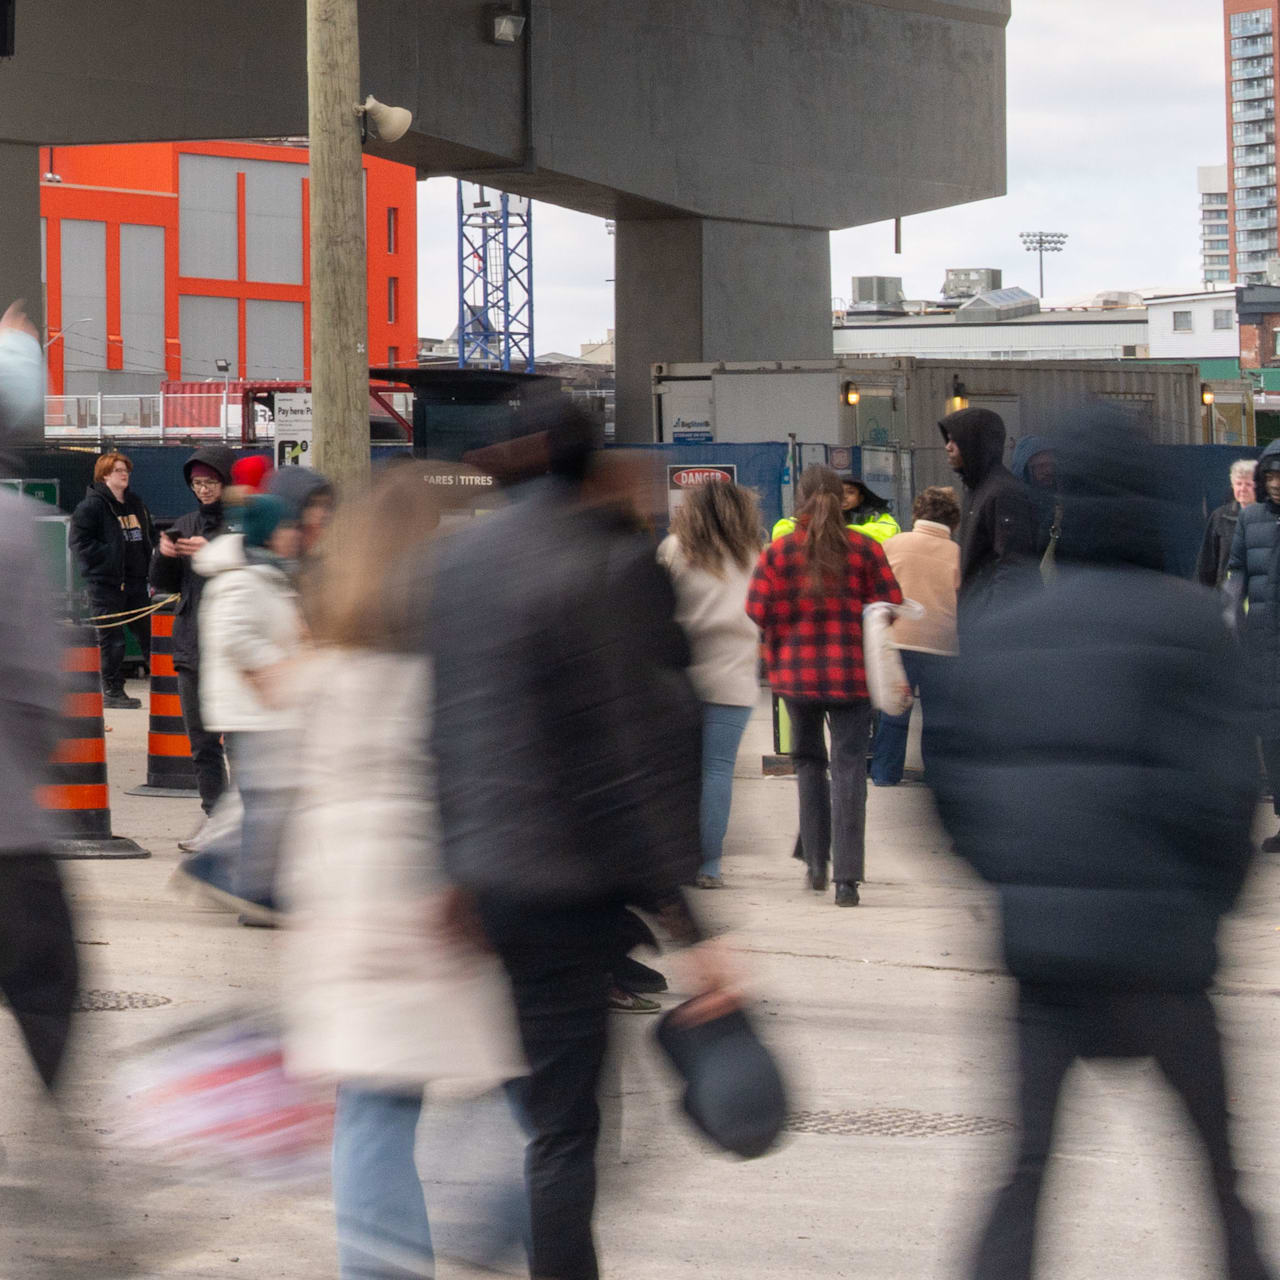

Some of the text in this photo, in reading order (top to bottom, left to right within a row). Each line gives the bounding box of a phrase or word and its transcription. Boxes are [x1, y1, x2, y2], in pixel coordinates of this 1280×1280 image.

[278, 407, 289, 417] Pay
[423, 475, 493, 485] FARES TITRES
[680, 472, 722, 484] DANGER
